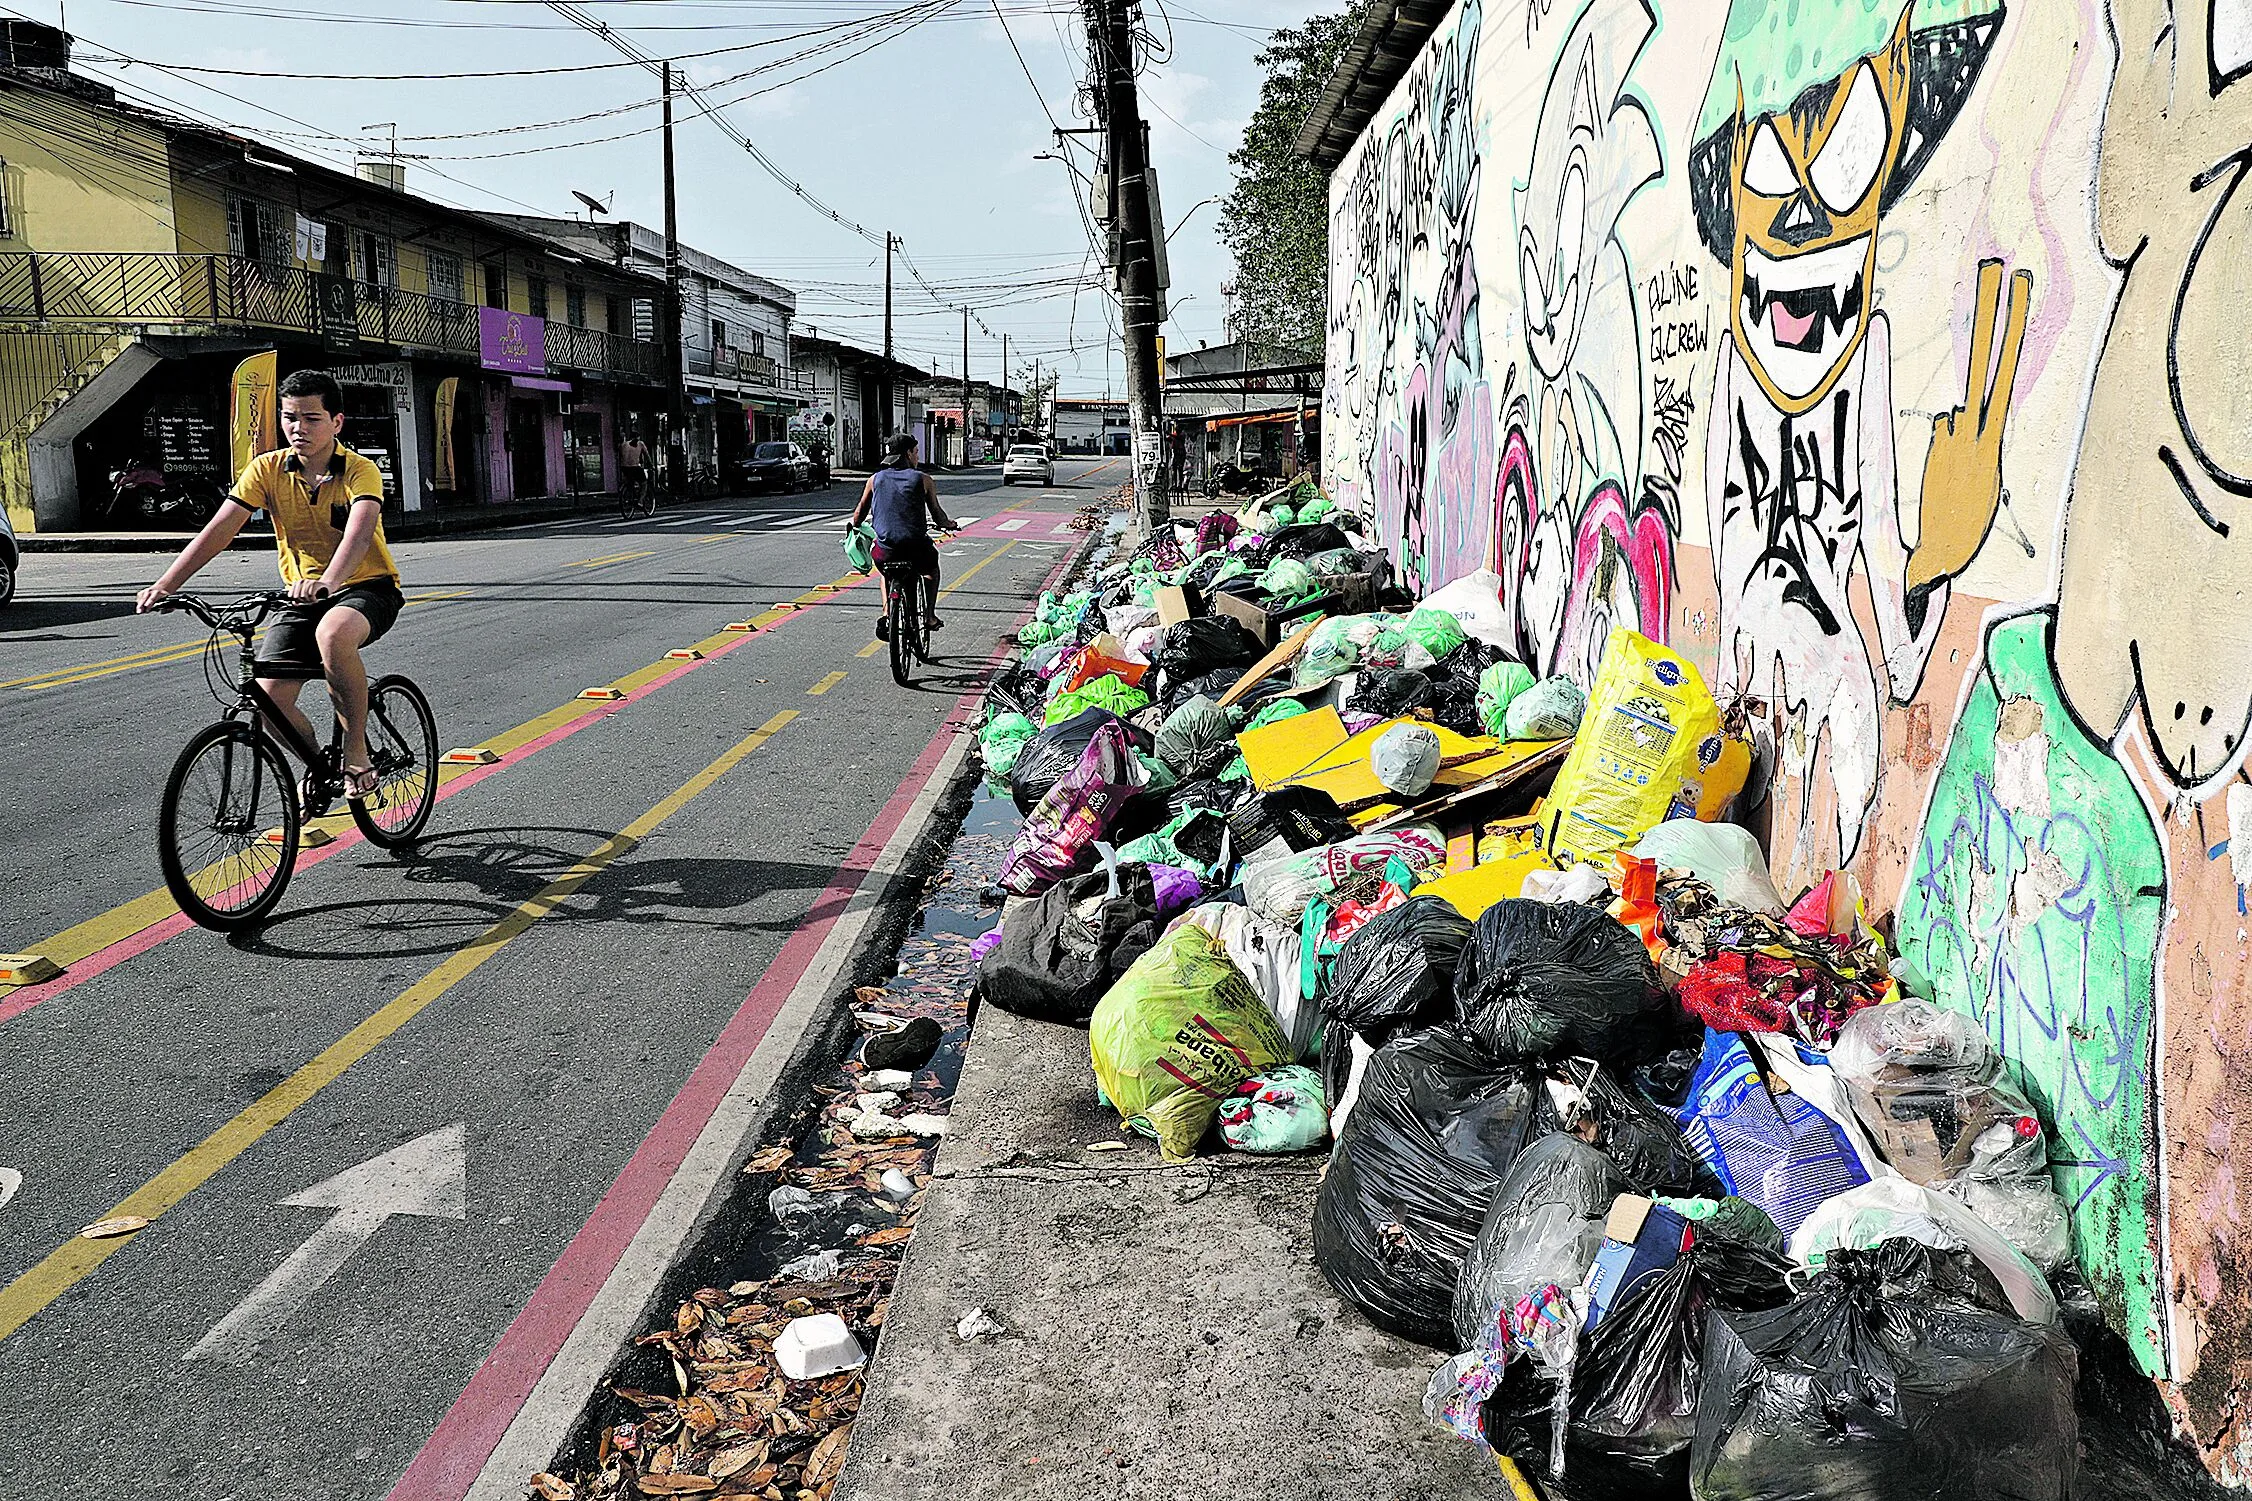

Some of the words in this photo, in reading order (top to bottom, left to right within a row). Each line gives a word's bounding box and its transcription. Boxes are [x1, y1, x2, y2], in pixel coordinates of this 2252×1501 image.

[1651, 304, 1710, 364] Q.CREW
[393, 366, 405, 385] 23
[1141, 451, 1156, 462] 79
[1645, 657, 1690, 685] Pedigree
[1697, 725, 1727, 775] Pedigree
[1087, 789, 1101, 807] PLUS
[1583, 857, 1604, 869] MARS
